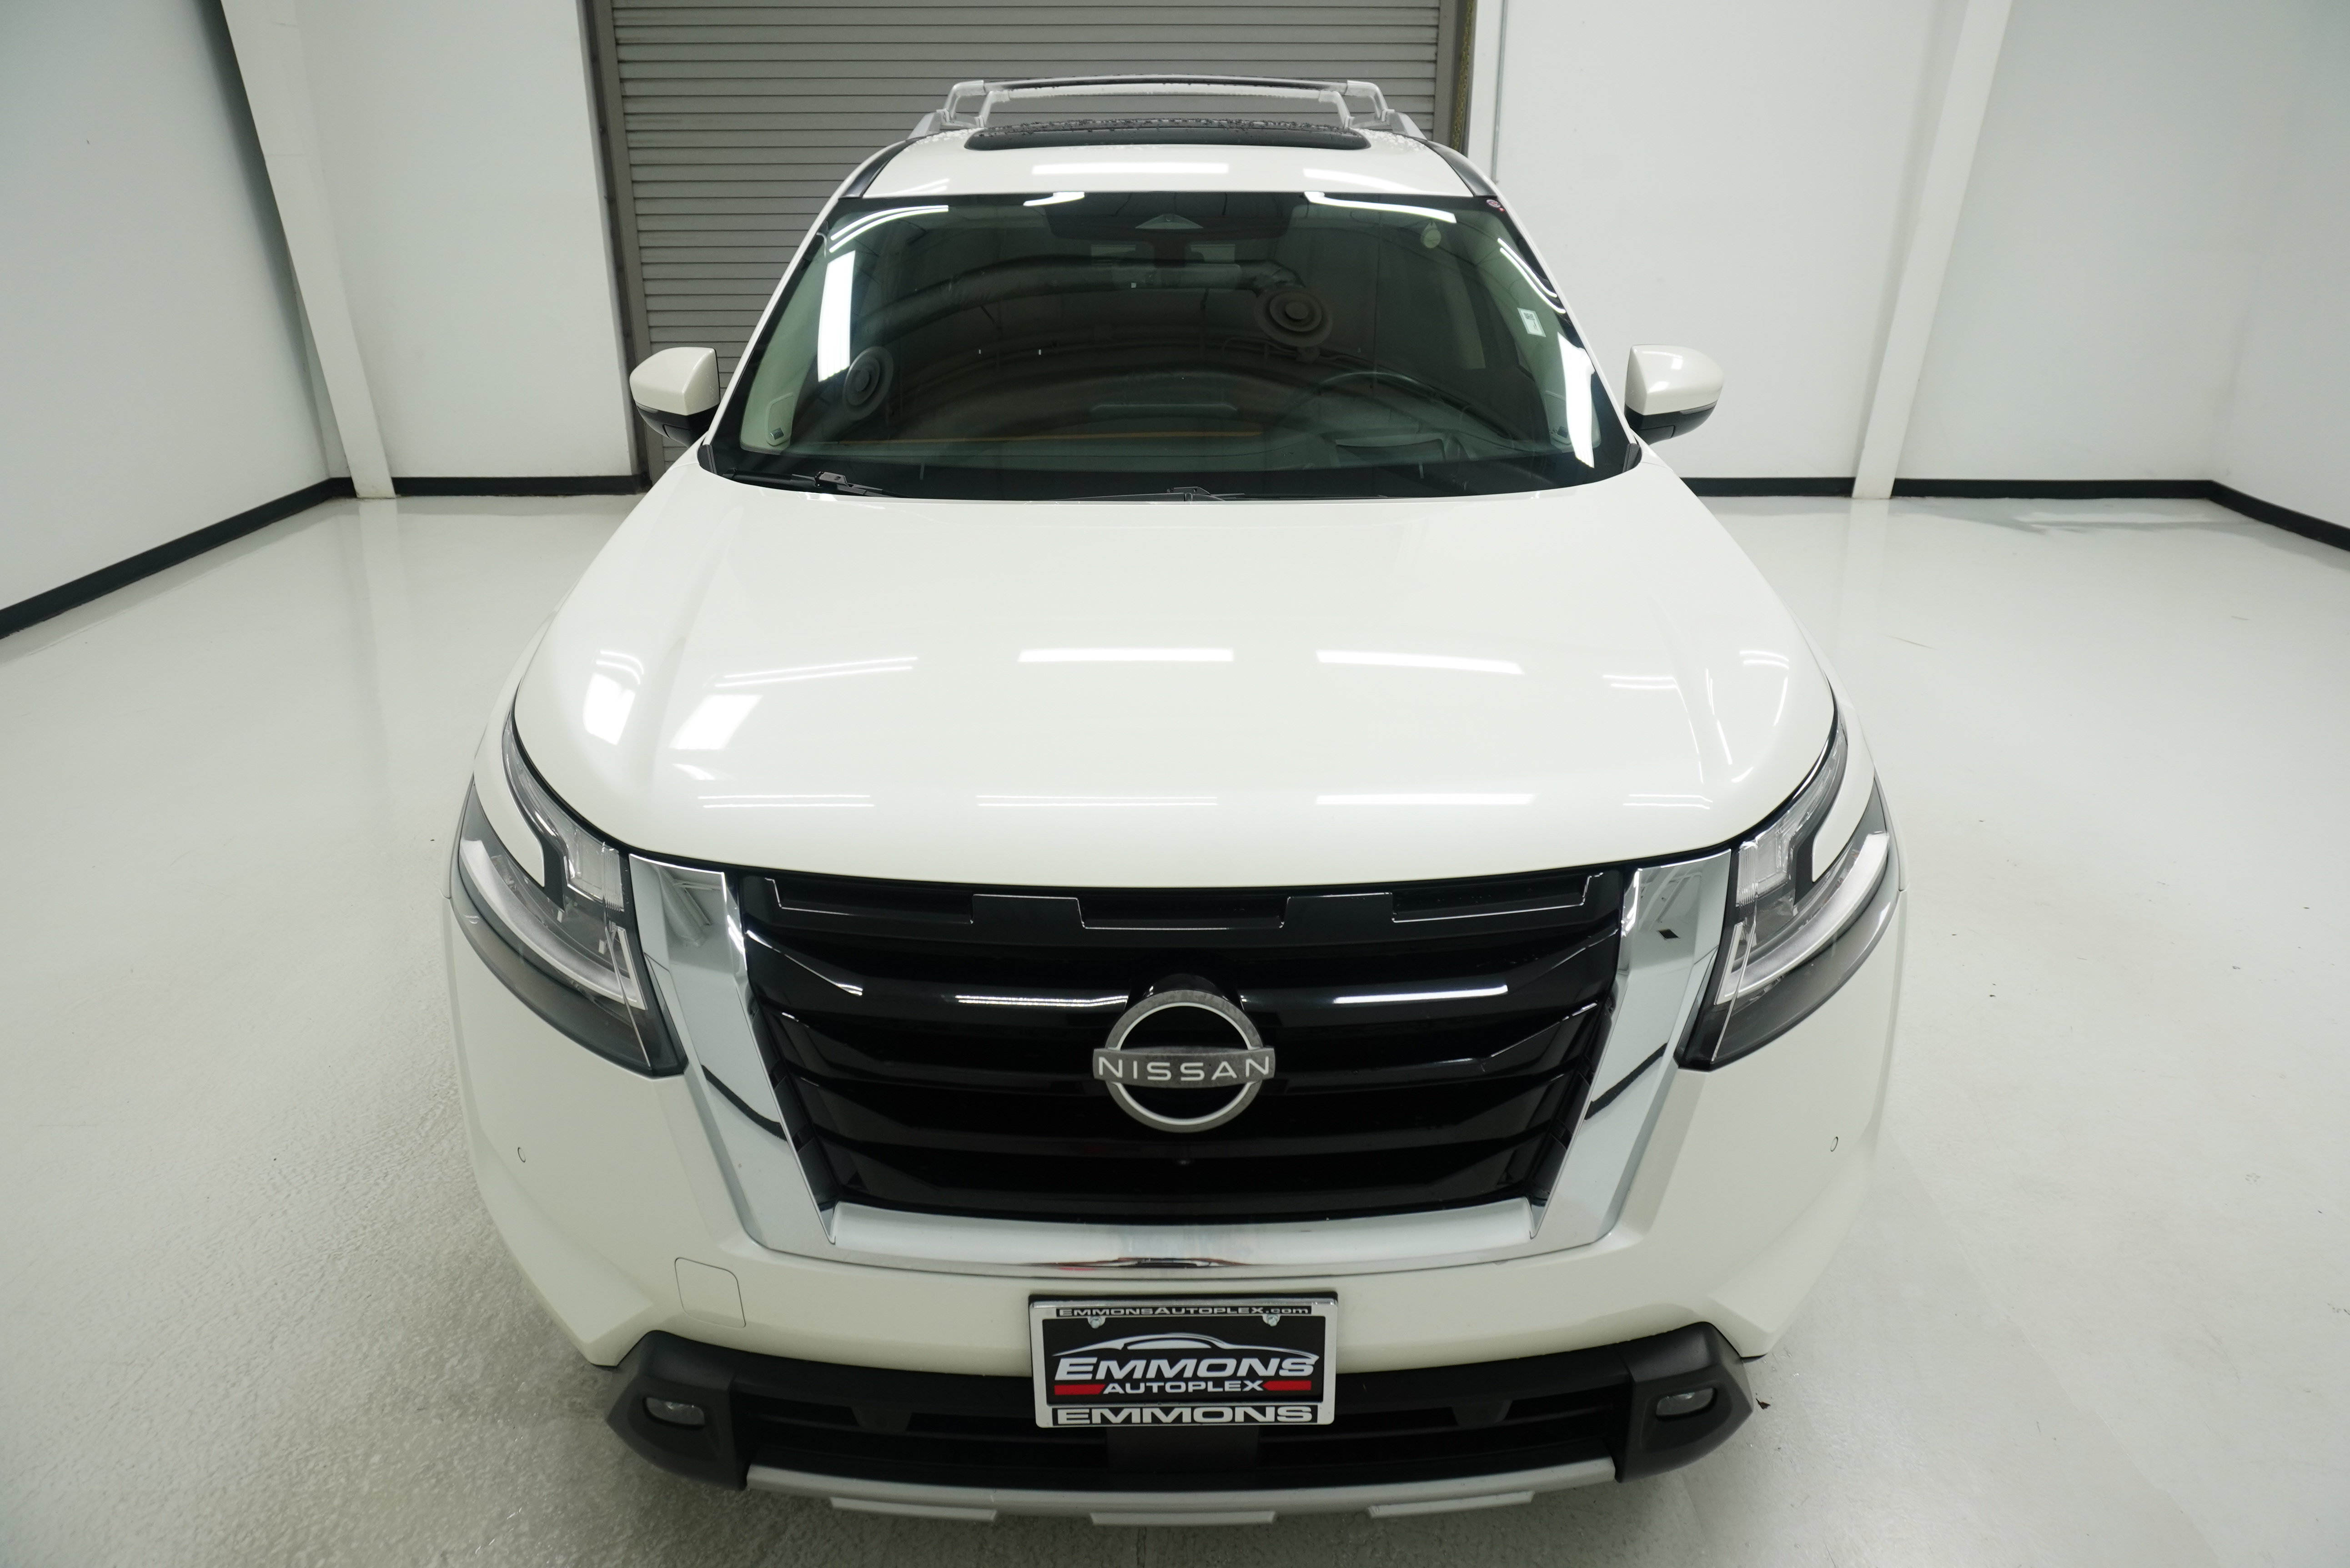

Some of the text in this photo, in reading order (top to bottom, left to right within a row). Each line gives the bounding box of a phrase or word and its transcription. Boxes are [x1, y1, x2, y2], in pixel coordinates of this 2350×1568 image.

[1098, 1056, 1270, 1081] NISSAN
[1054, 1357, 1316, 1381] EMMONS
[1103, 1380, 1264, 1394] AUTOPLEX
[1057, 1406, 1312, 1425] EMMONS
